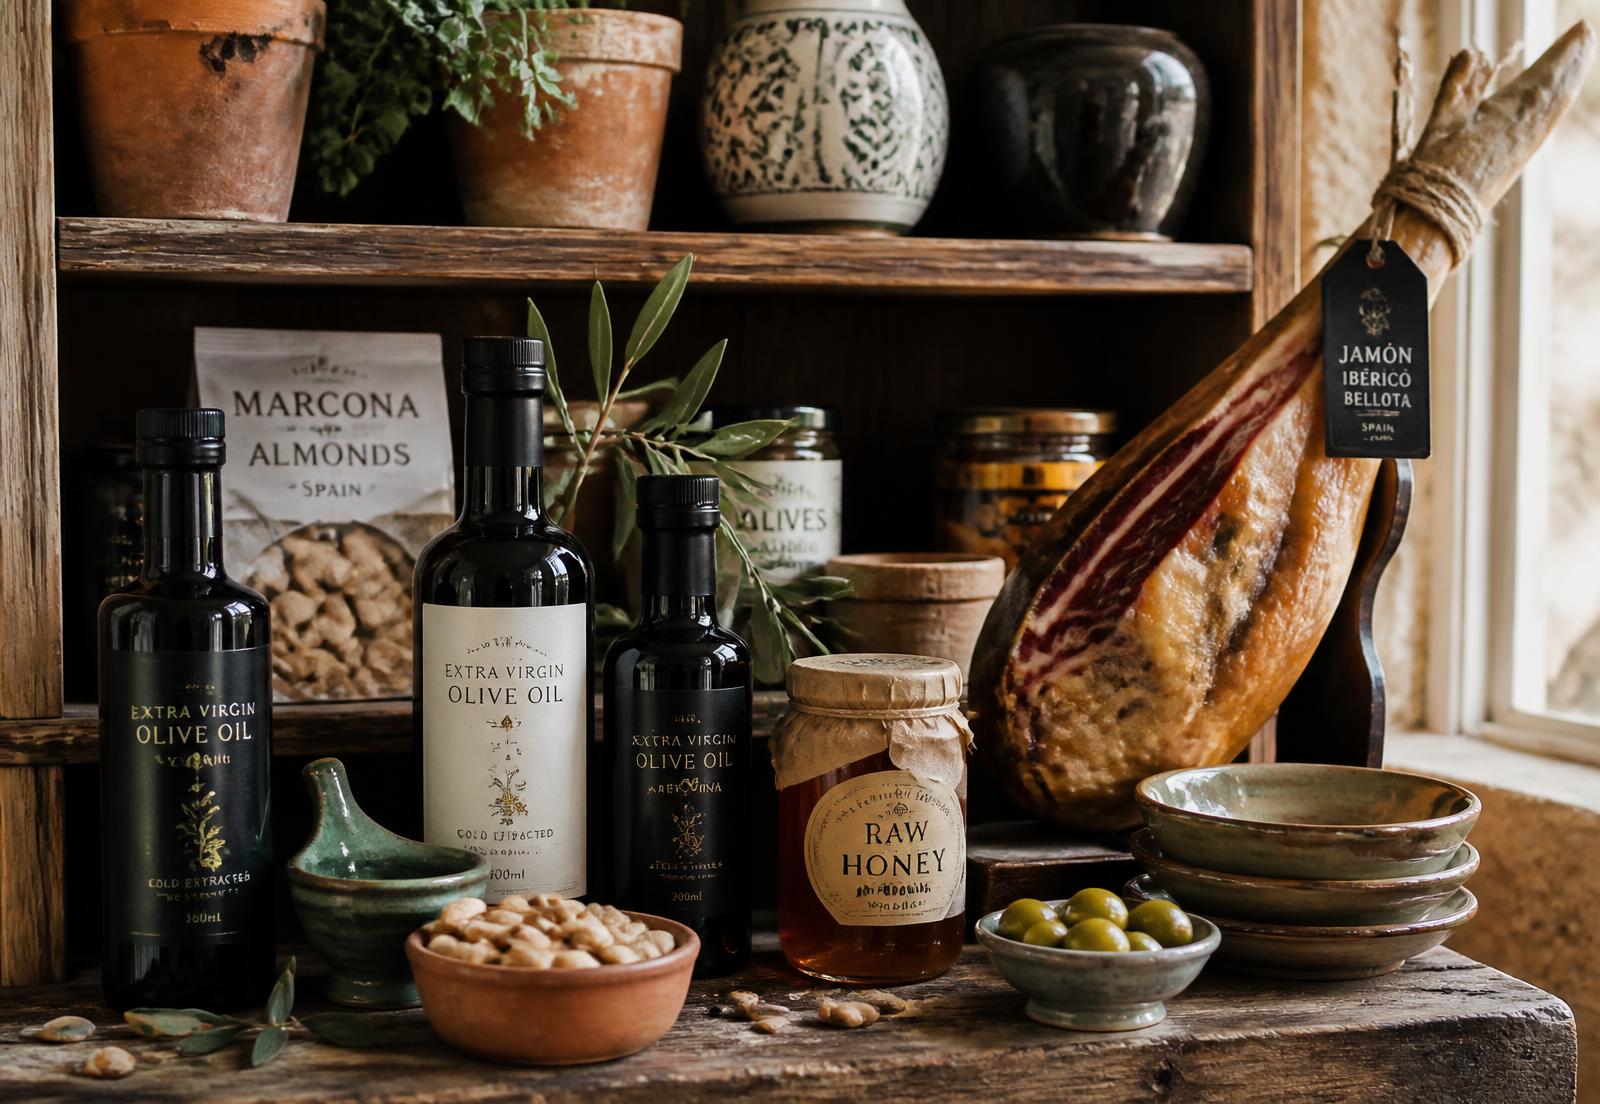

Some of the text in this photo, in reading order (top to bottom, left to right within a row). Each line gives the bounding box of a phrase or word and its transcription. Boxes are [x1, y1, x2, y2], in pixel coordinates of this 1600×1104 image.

[233, 390, 419, 419] MARCONA
[1344, 391, 1412, 408] BELLOTA
[249, 442, 411, 467] ALMONDS
[303, 480, 361, 498] SPAIN
[445, 663, 564, 679] EXTRA VIRGIN
[448, 685, 563, 705] OLIVE OIL
[131, 702, 256, 720] EXTRA VIRGIN
[136, 721, 252, 744] OLIVE OIL
[688, 734, 736, 746] VIRGIN
[636, 752, 733, 770] OLIVE OIL
[865, 820, 929, 845] RAW
[842, 848, 946, 877] HONEY
